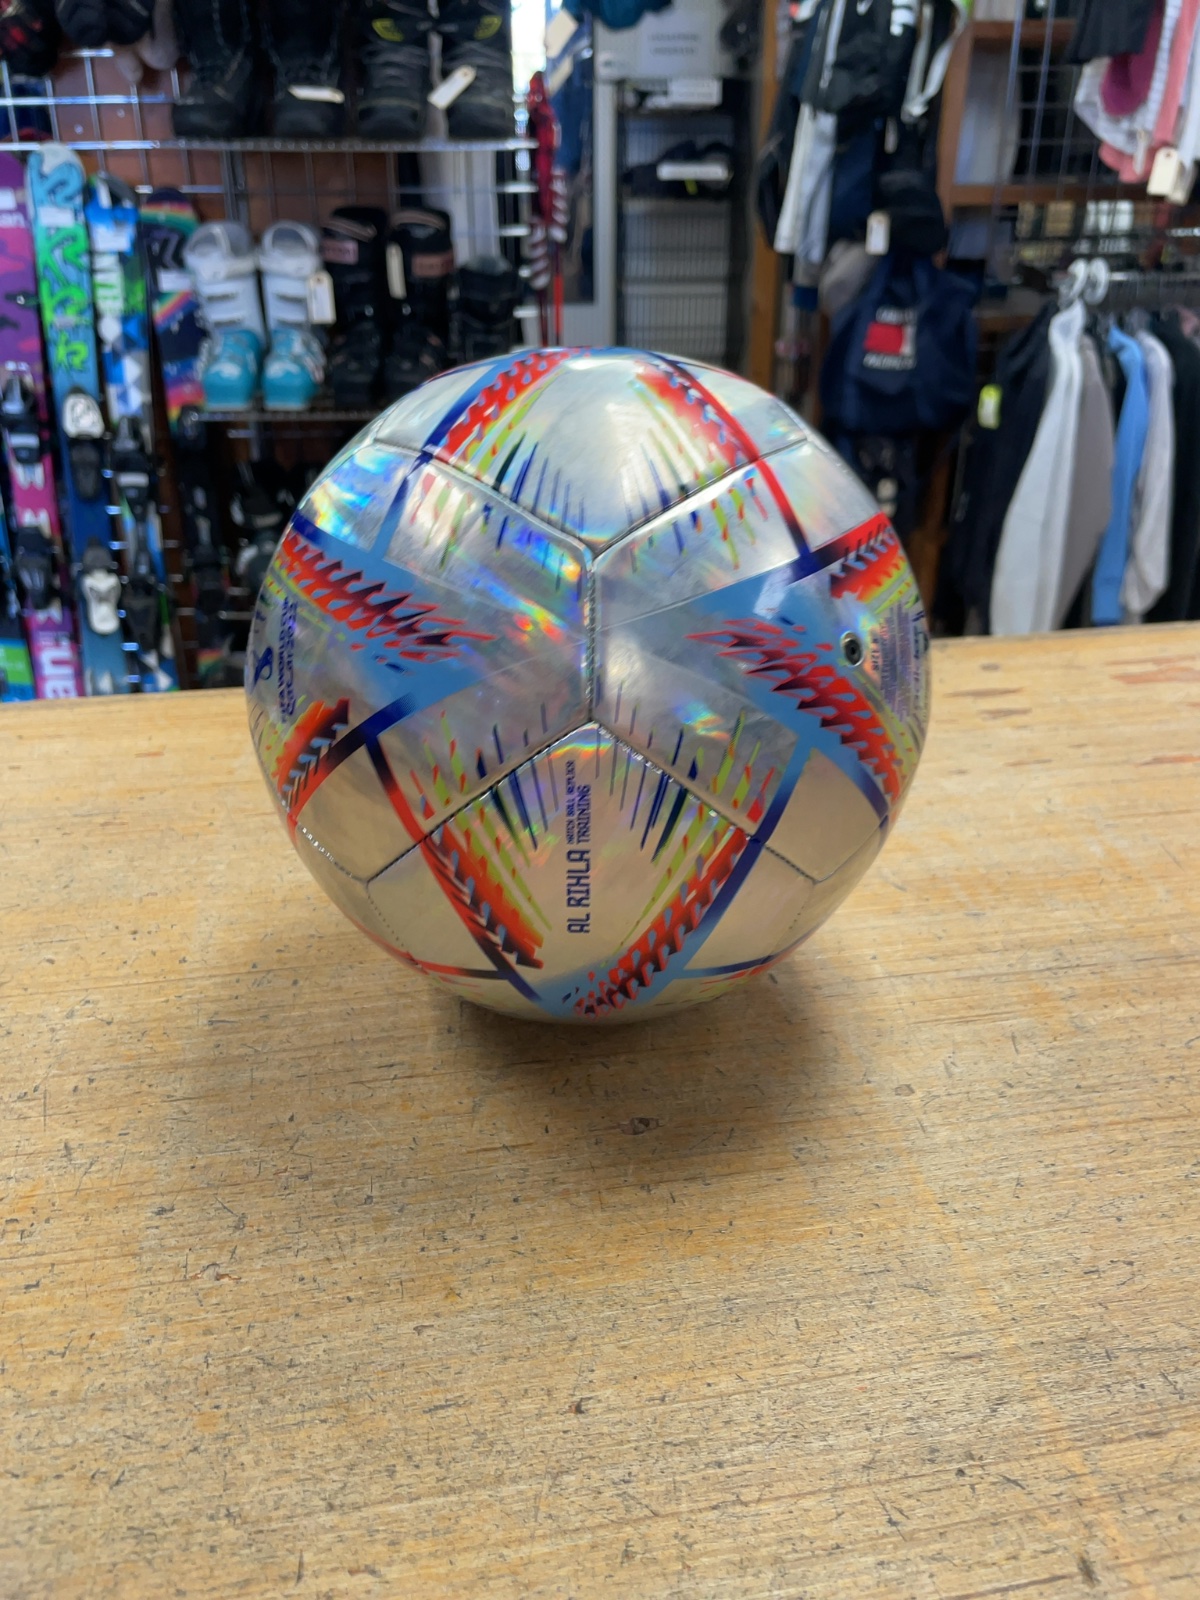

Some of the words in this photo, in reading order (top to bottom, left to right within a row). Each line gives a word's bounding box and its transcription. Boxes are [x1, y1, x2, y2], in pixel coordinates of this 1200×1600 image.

[577, 784, 591, 844] TRAINING
[566, 849, 591, 907] RIHLA
[566, 912, 591, 933] AL
